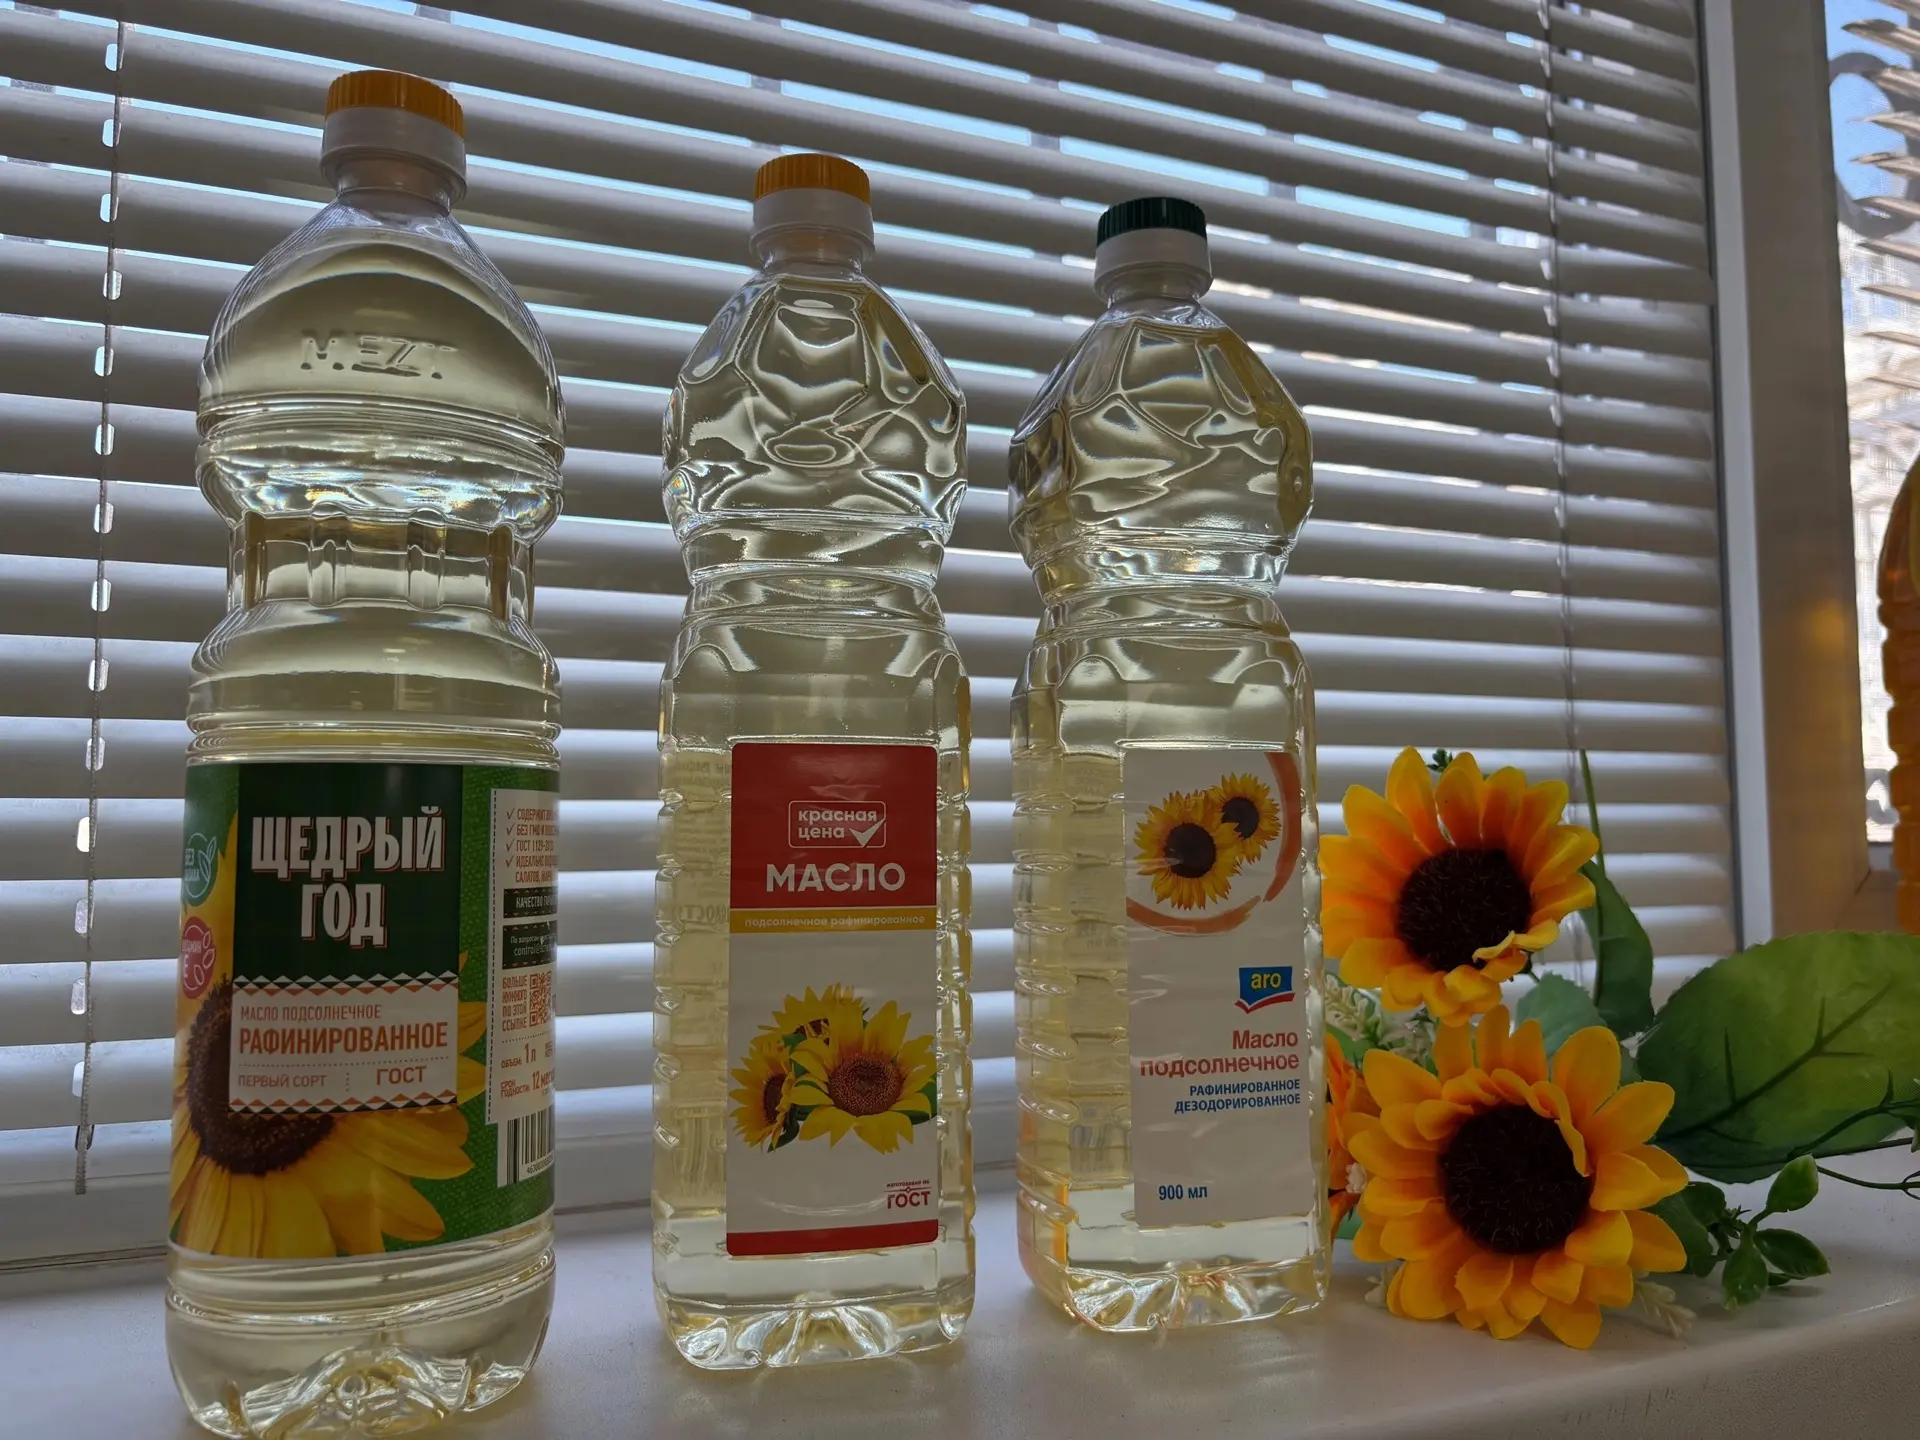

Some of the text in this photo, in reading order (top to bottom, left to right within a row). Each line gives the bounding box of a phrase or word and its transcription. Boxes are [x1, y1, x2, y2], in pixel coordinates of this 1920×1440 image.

[798, 809, 878, 825] красная
[516, 824, 528, 836] БЕЗ
[798, 826, 845, 841] цена
[251, 806, 445, 881] ЩЕДРЫЙ
[516, 839, 531, 852] ГОСТ
[766, 862, 906, 893] МАСЛО
[515, 896, 543, 909] КАЧЕСТВО
[301, 883, 387, 948] ГОД
[745, 915, 926, 928] подсолнечное рафинированное
[502, 975, 528, 989] БОЛЬШЕ
[1251, 972, 1282, 989] aro
[240, 1004, 382, 1022] МАСЛО ПОДСОЛНЕЧНОЕ
[502, 1001, 527, 1018] ПО ЭТОЙ
[502, 1017, 527, 1032] ССЫЛКЕ
[239, 1022, 449, 1055] РАФИНИРОВАННОЕ
[1232, 1029, 1299, 1050] Масло
[525, 1043, 530, 1064] 1
[1140, 1053, 1300, 1078] подсолнечное
[237, 1073, 328, 1088] ПЕРВЫЙ СОРТ
[376, 1066, 427, 1086] ГОСТ
[532, 1070, 540, 1091] 12
[1189, 1078, 1301, 1097] РАФИНИРОВАННОЕ
[1174, 1093, 1301, 1114] ДЕЗОДОРИРОВАННОЕ
[887, 1191, 931, 1210] ГОСТ
[1158, 1184, 1208, 1201] 900 мл
